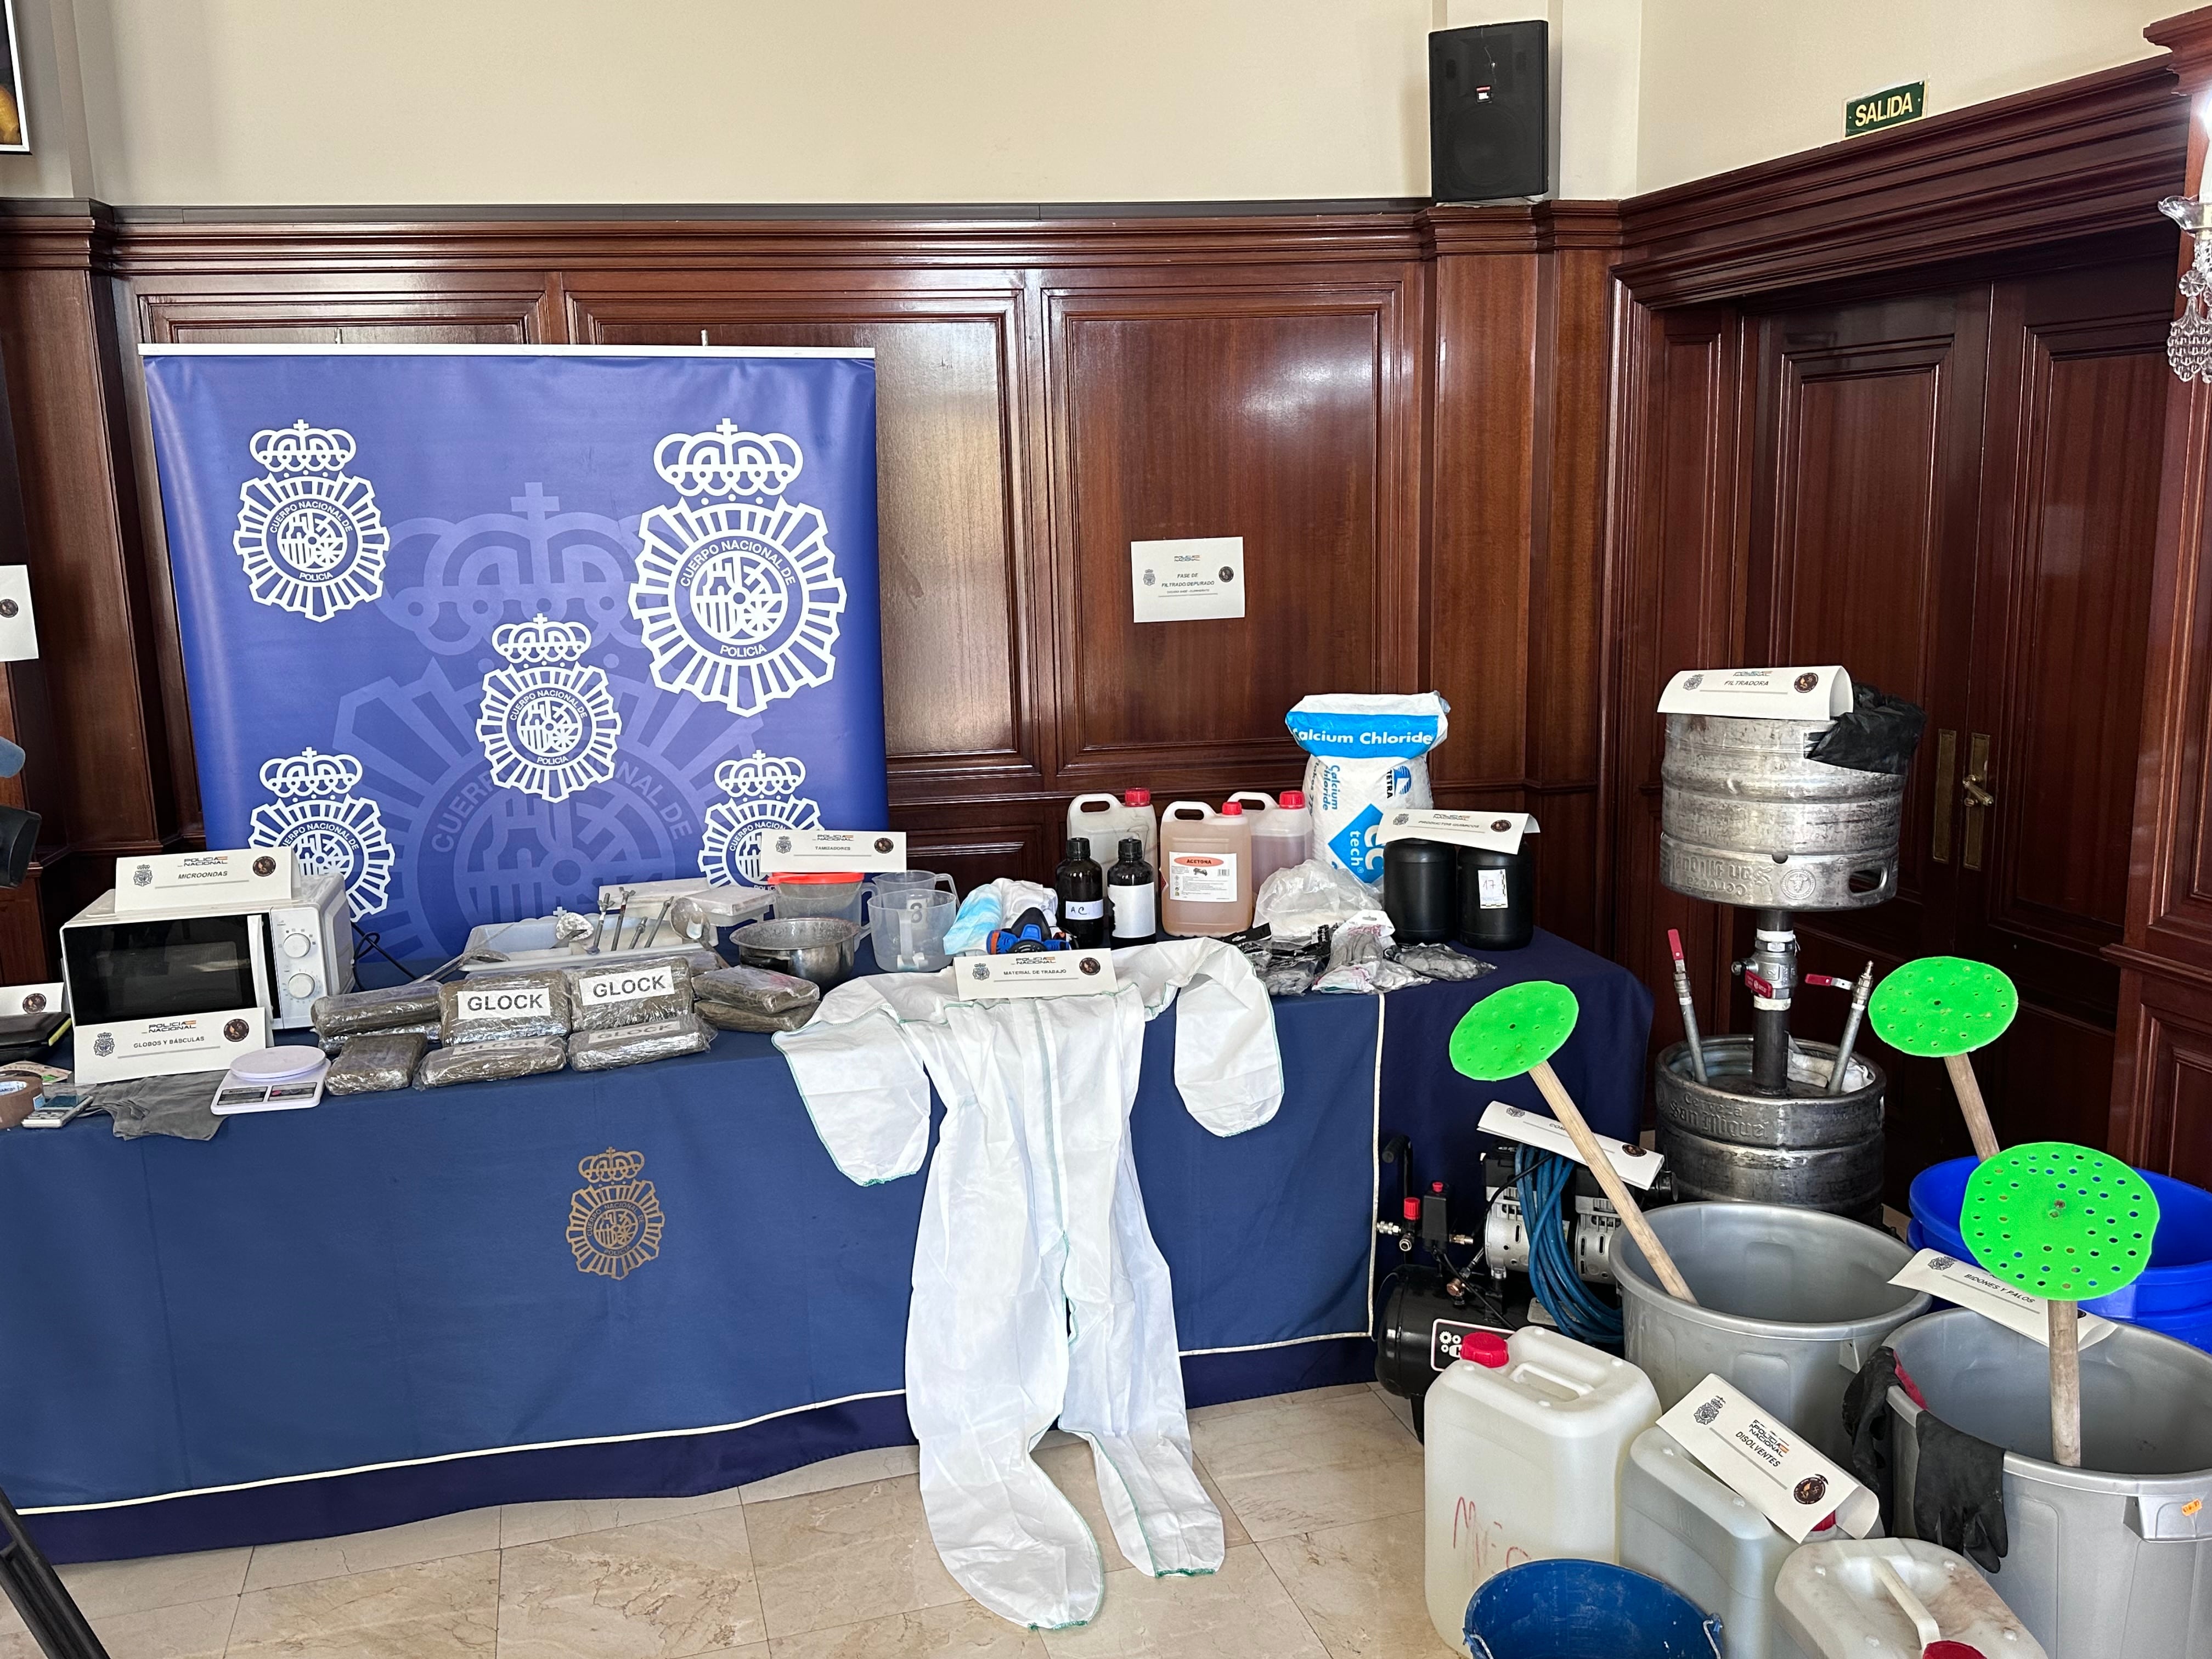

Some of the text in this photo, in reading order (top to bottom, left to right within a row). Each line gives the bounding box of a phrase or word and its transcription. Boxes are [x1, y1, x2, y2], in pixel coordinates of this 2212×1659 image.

[1855, 92, 1913, 127] SALIDA
[269, 500, 353, 533] CUERPO NACIONAL DE
[680, 539, 797, 587] CUERPO NACIONAL DE
[719, 644, 768, 657] POLICIA
[510, 689, 588, 721] CUERPO NACIONAL DE
[1359, 731, 1433, 745] Chloride
[1329, 765, 1340, 810] Calcium
[660, 801, 693, 840] DE
[283, 822, 360, 851] UERPO NACIONAL DE
[729, 825, 754, 851] CUERPO
[178, 871, 228, 879] MICROONDAS
[1482, 879, 1496, 890] 17
[1687, 877, 1747, 896] Cerveza
[592, 975, 666, 998] GLOCK
[467, 994, 543, 1011] GLOCK
[148, 1025, 196, 1033] NACIONAL
[597, 1023, 672, 1040] GLOCK
[133, 1040, 161, 1048] GLOBOS
[1669, 1099, 1698, 1125] San
[1684, 1092, 1742, 1118] Cerveza
[586, 1202, 644, 1237] CUERPO NACIONAL DE
[604, 1245, 631, 1256] POLICIA
[1964, 1274, 2001, 1289] BIDONES
[2006, 1290, 2035, 1303] PALOS
[1735, 1431, 1781, 1467] DISOLVENTES
[1749, 1429, 1784, 1458] NACIONAL
[1753, 1424, 1781, 1448] POLICIA
